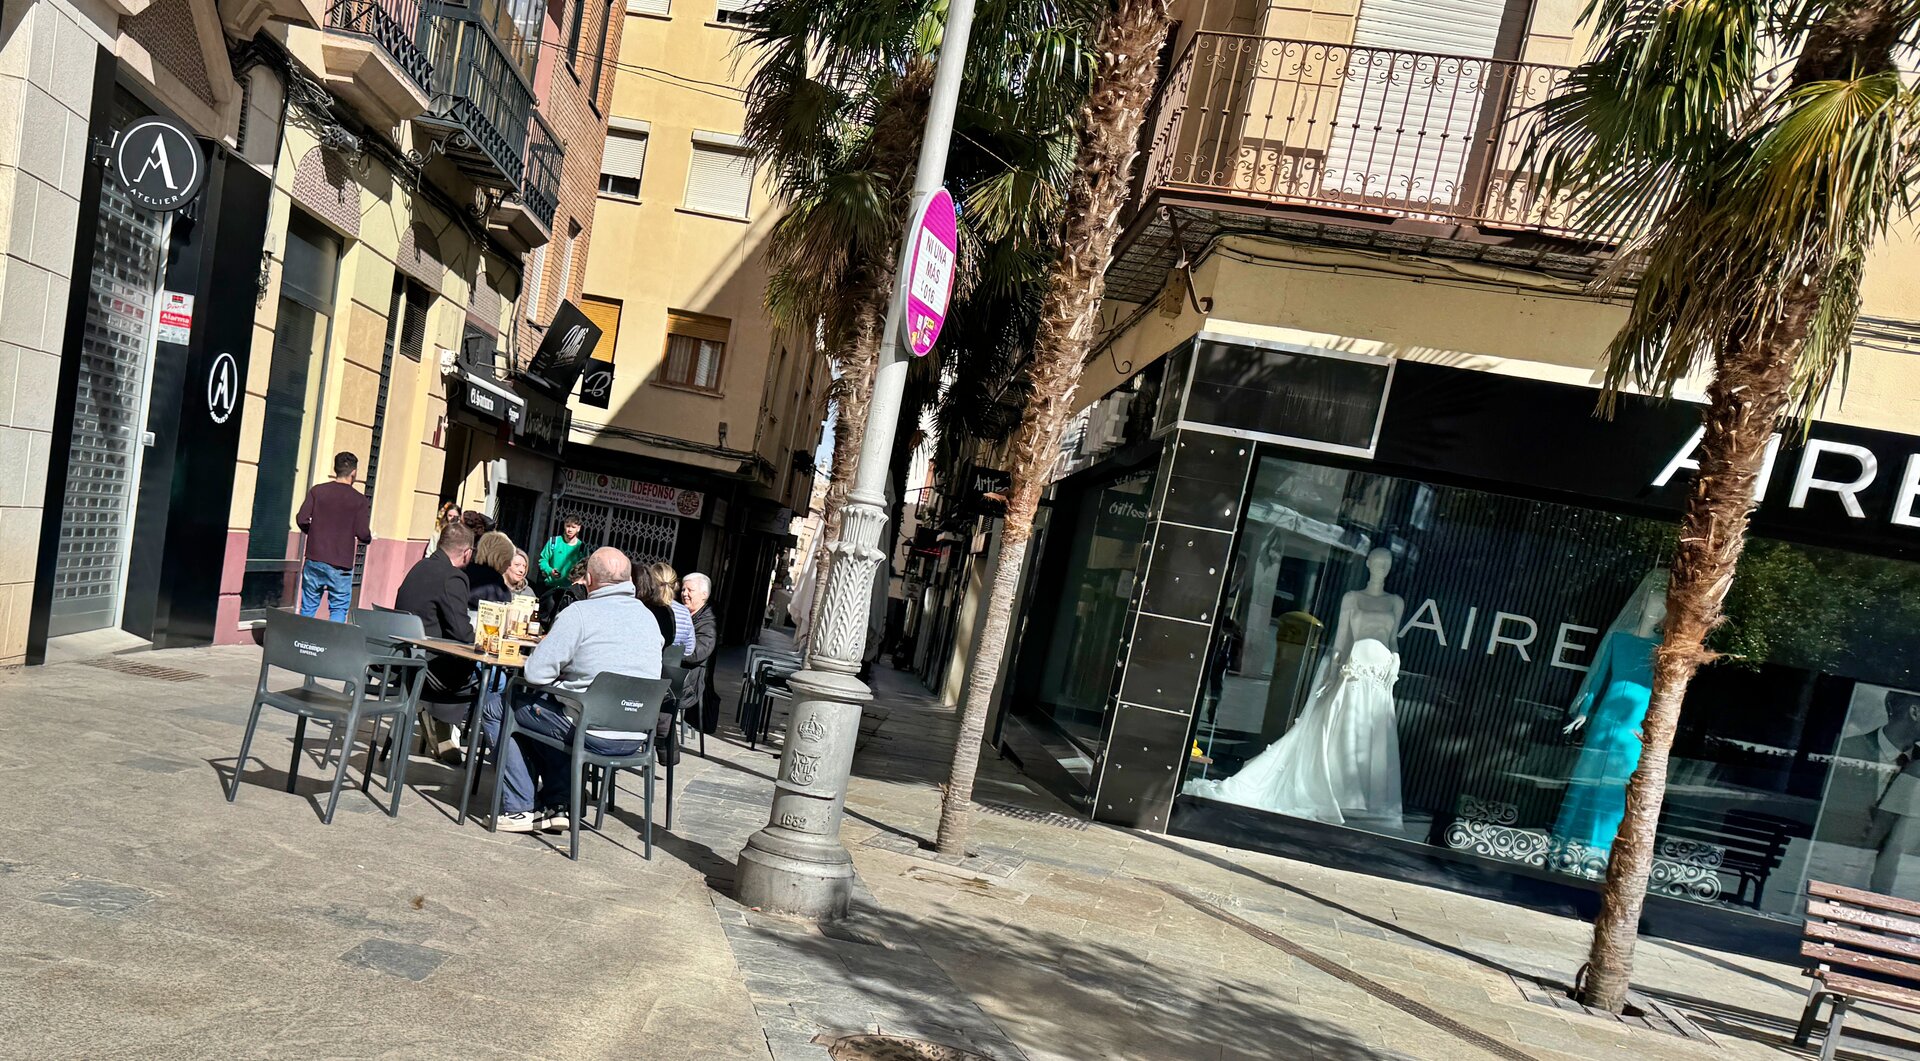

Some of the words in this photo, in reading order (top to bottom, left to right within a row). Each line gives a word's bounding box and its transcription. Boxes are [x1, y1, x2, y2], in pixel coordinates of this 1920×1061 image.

[130, 188, 179, 205] ATELIER
[926, 235, 934, 255] NI
[934, 242, 947, 267] UNA
[925, 261, 940, 285] MÁS
[923, 284, 935, 304] 016
[162, 312, 190, 323] Alarma
[611, 477, 628, 492] SAN
[629, 480, 675, 501] ILDEFONSO
[1398, 598, 1598, 672] AIRE
